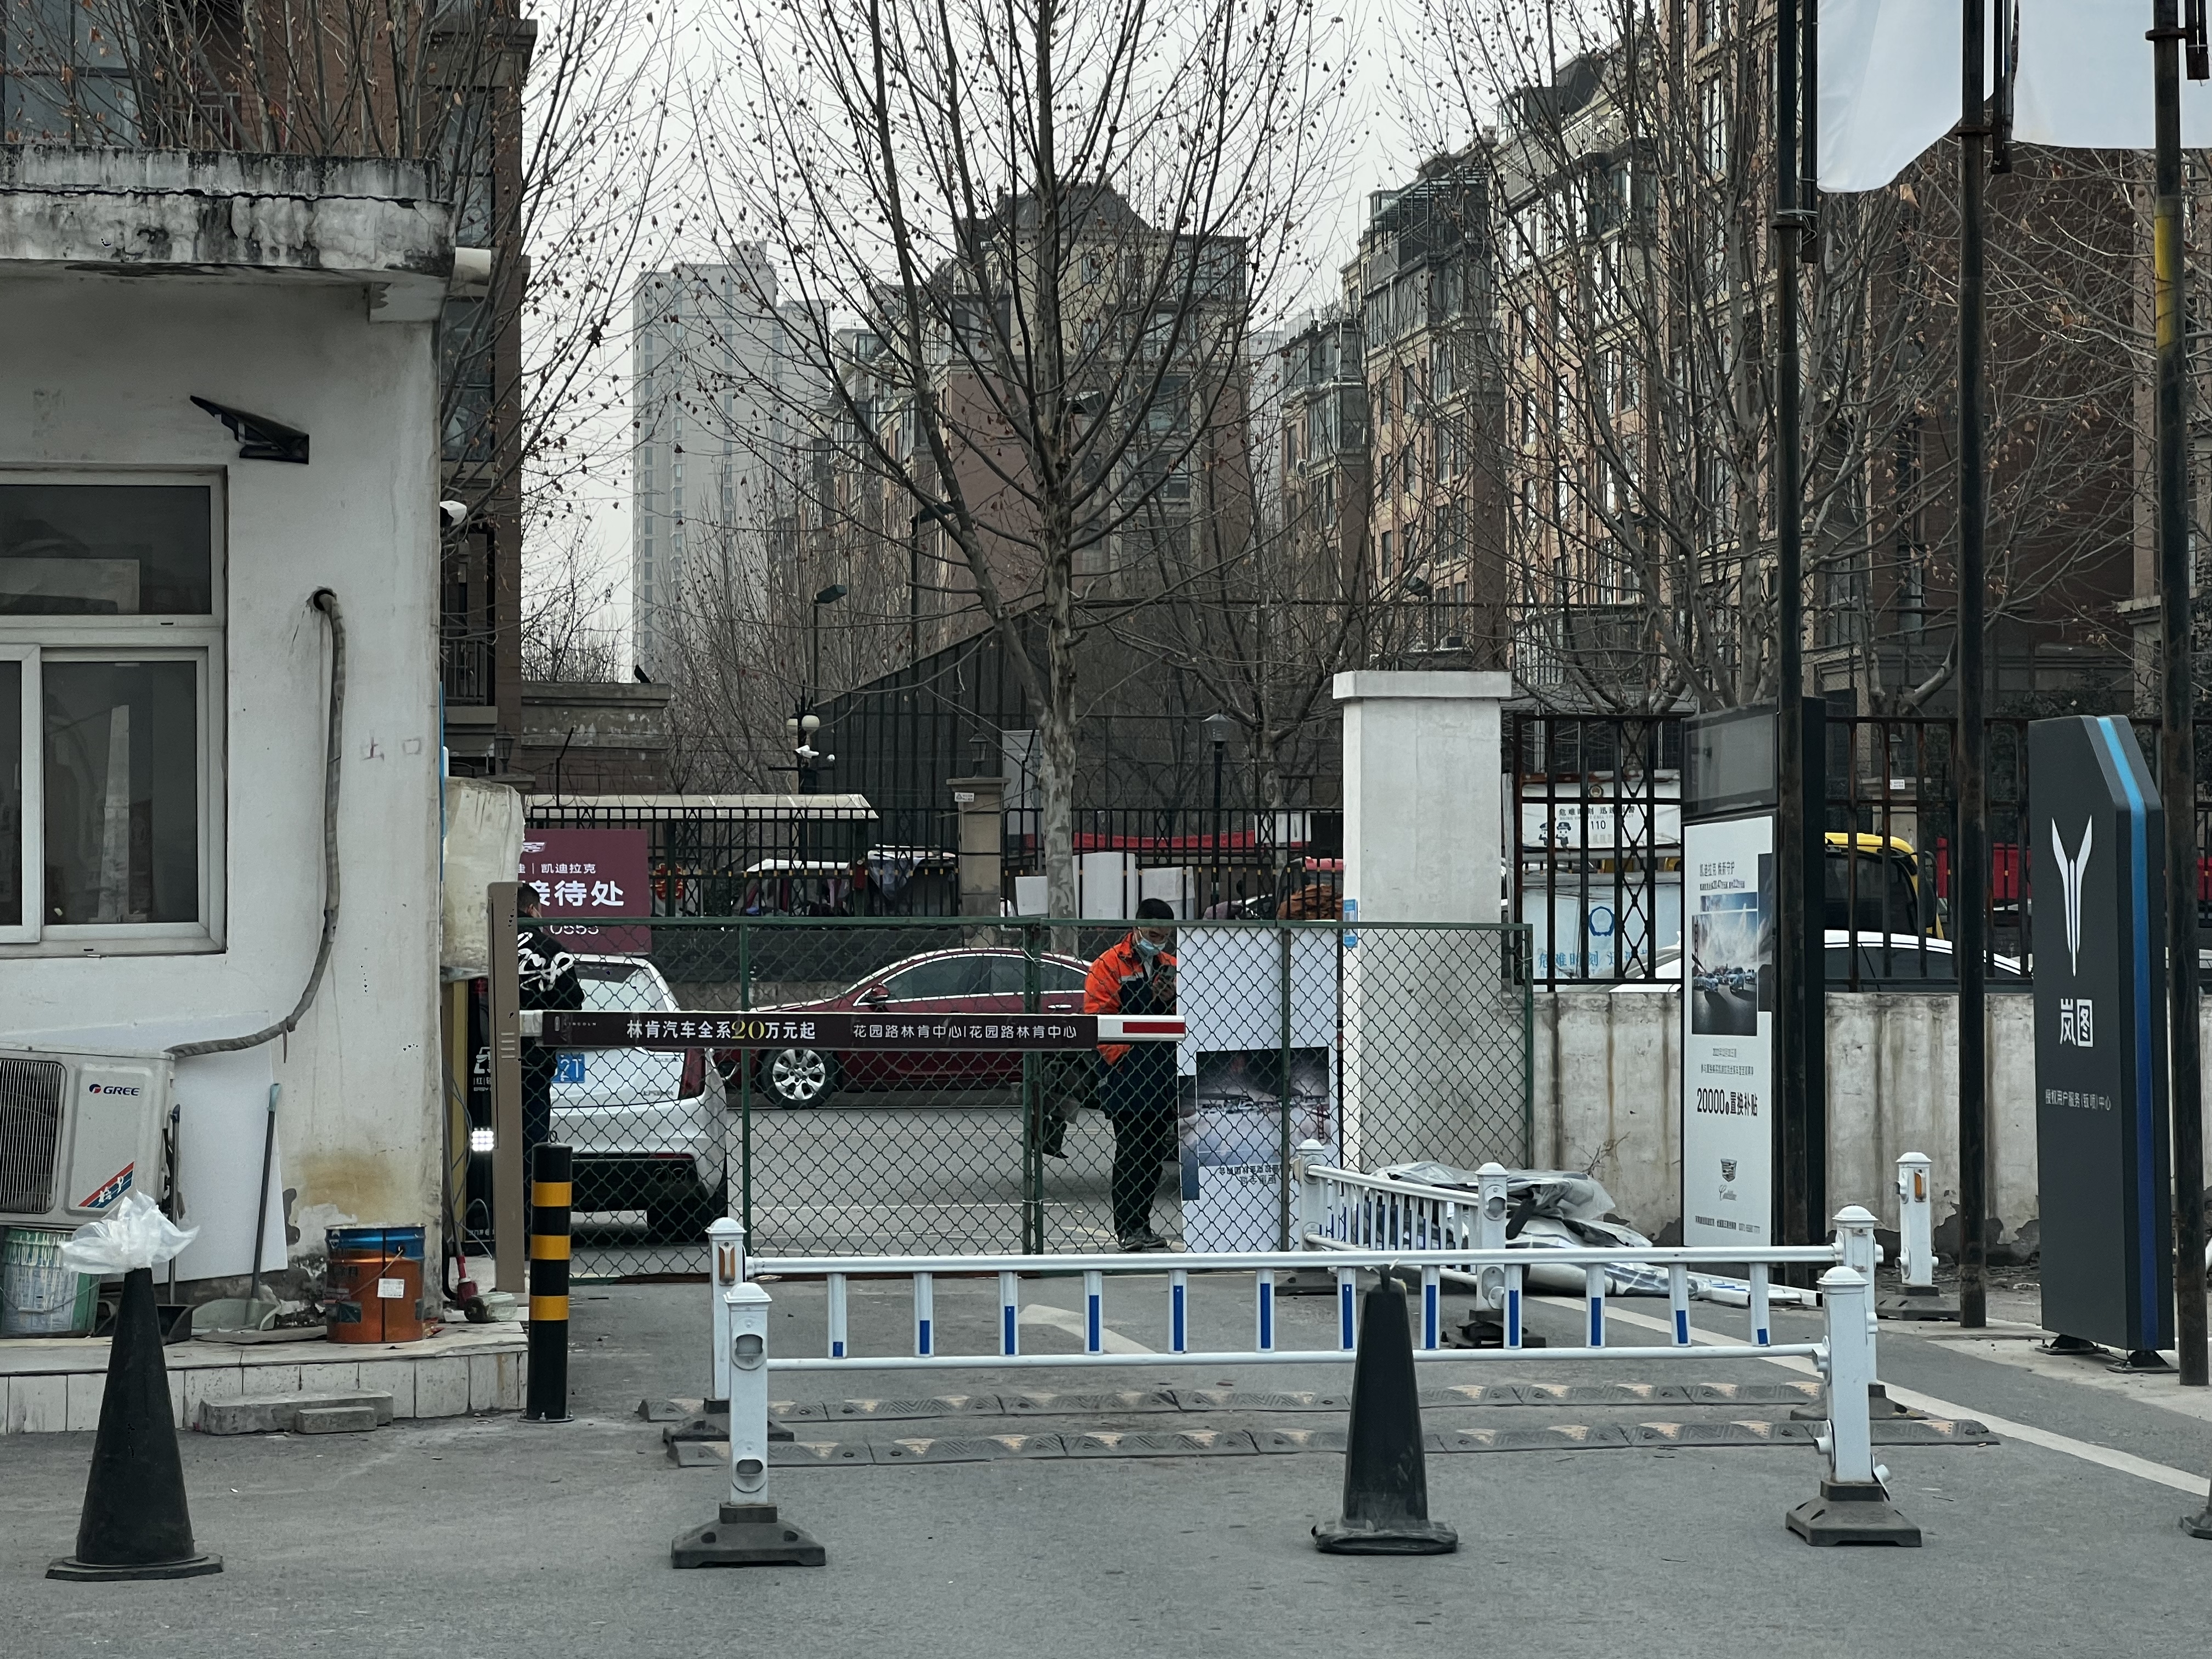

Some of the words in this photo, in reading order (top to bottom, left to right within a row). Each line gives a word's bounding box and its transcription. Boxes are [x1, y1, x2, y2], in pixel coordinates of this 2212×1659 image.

[1591, 820, 1606, 830] 110
[541, 863, 596, 874] 凯迪拉克
[2060, 998, 2093, 1047] 岚图
[627, 1019, 815, 1040] 林肯汽车全系20万元起
[103, 1086, 140, 1096] GREE
